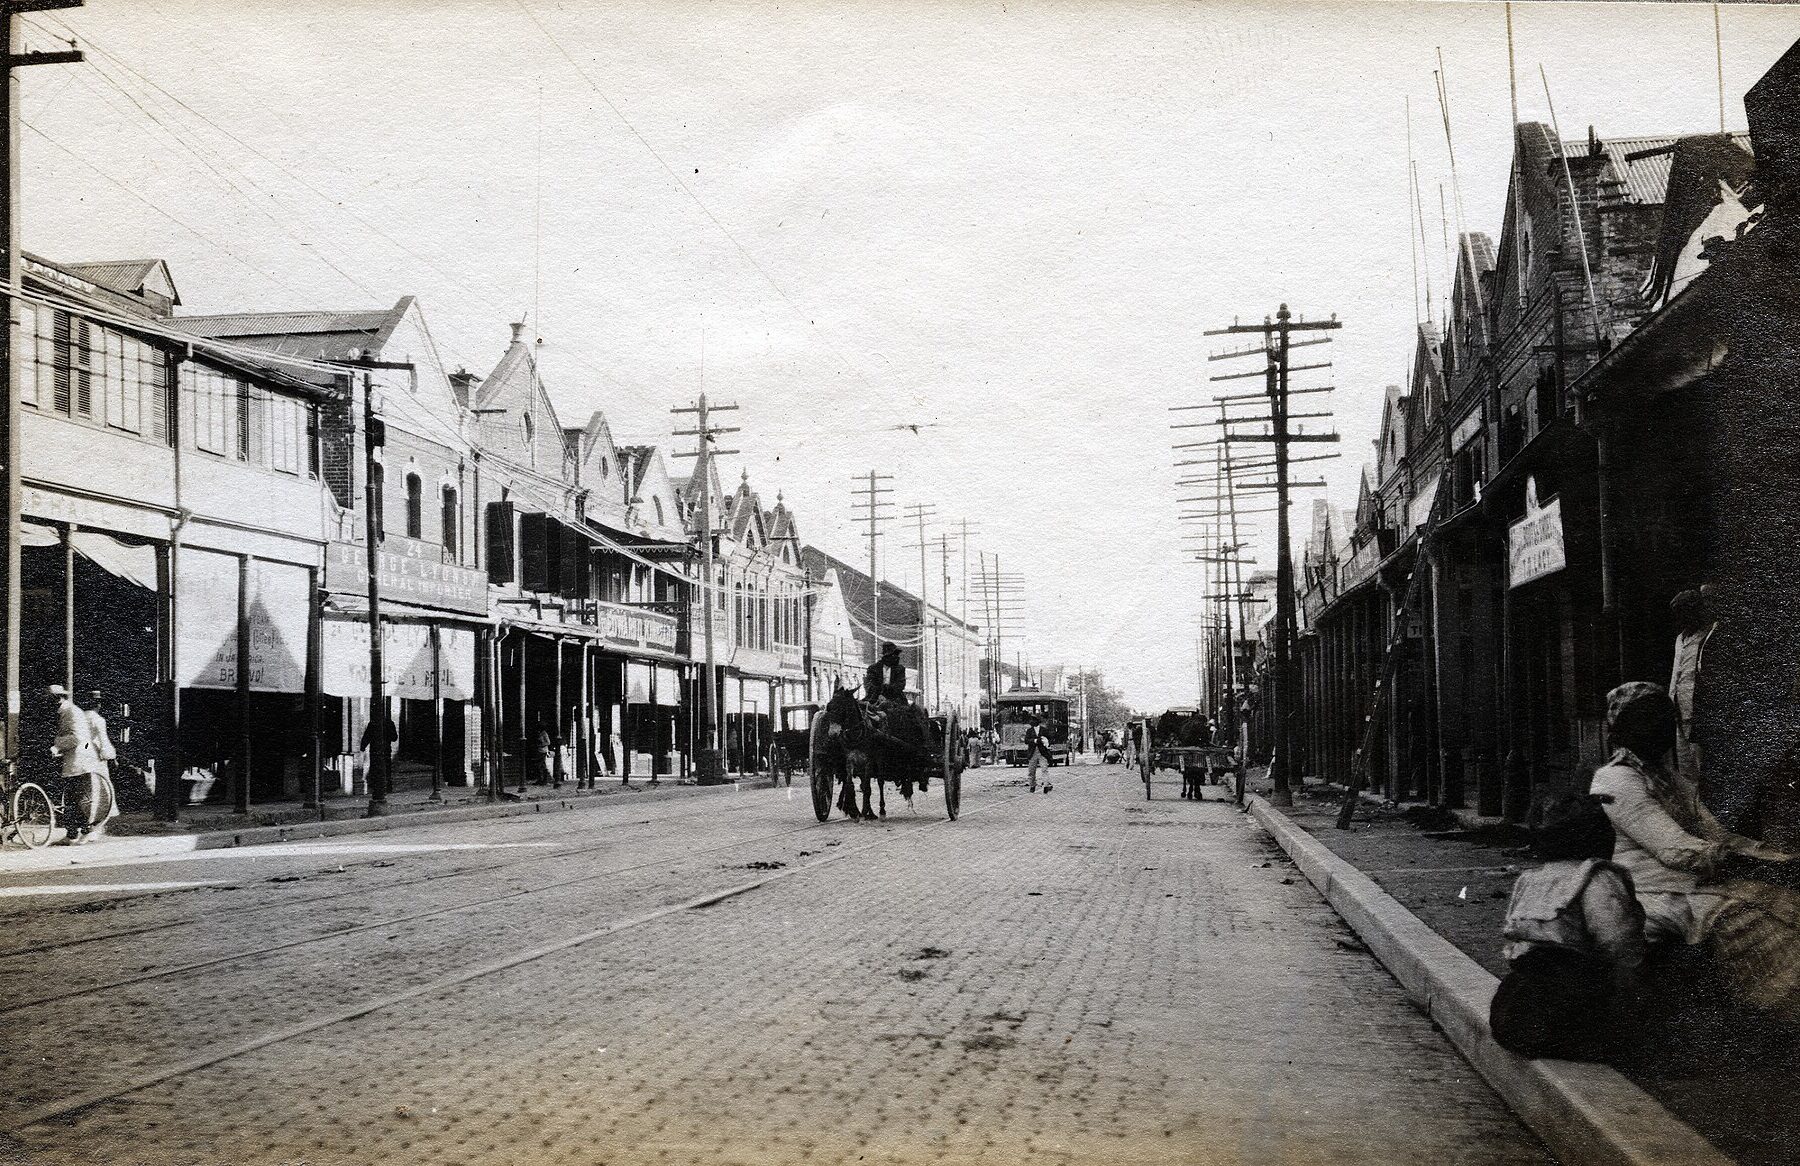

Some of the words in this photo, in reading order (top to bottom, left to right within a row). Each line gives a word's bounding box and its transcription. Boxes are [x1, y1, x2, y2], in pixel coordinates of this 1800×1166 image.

[407, 540, 423, 558] 24
[341, 546, 408, 575] GERGE
[219, 667, 265, 684] BRVO!
